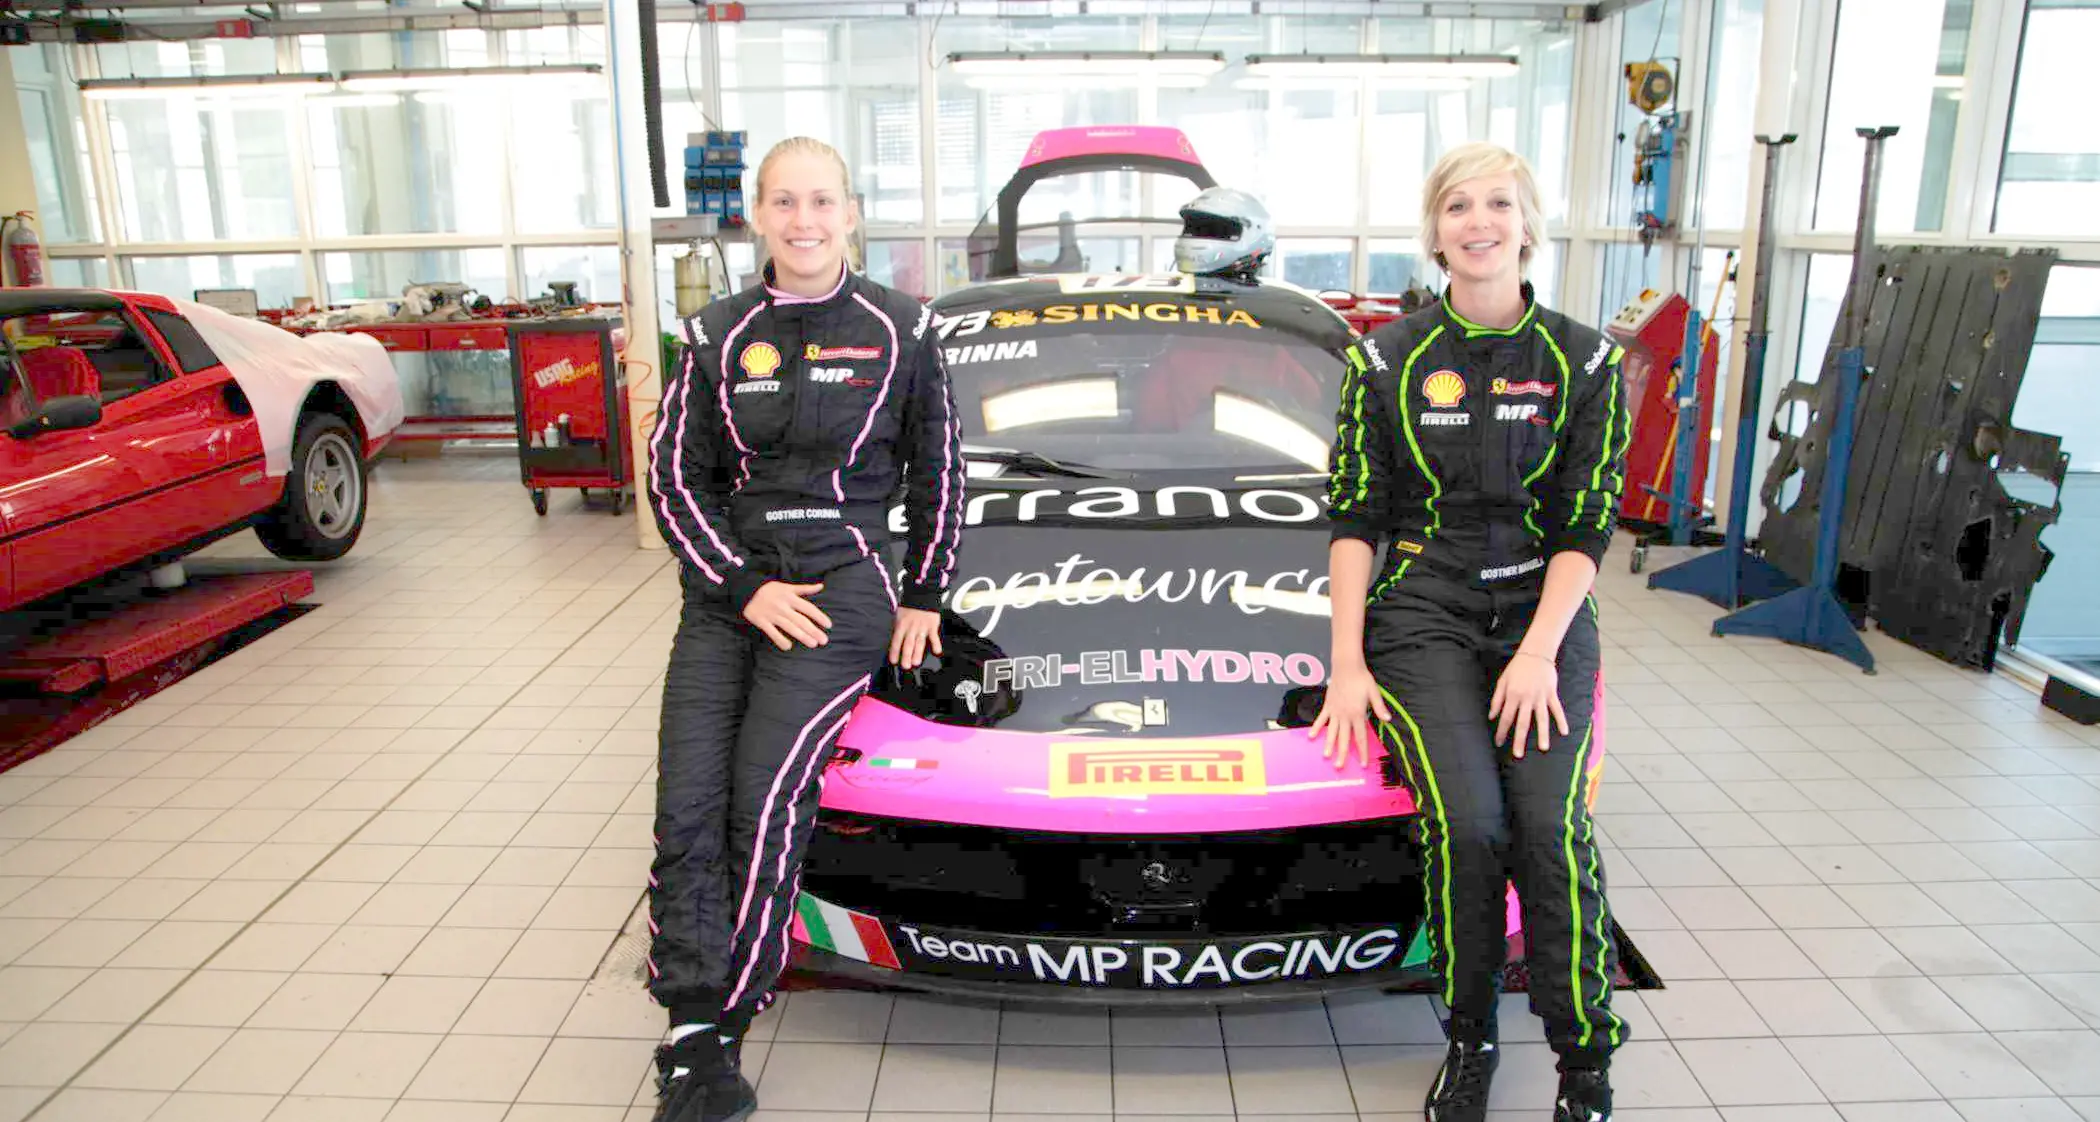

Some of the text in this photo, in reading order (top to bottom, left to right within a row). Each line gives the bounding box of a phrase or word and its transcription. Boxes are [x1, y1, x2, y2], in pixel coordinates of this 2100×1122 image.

[1041, 303, 1261, 329] SINGHA
[1420, 412, 1471, 426] PIRELLI
[888, 486, 1332, 532] rrano
[1067, 750, 1245, 784] PIRELLI
[900, 925, 1399, 985] Team MP RACING
